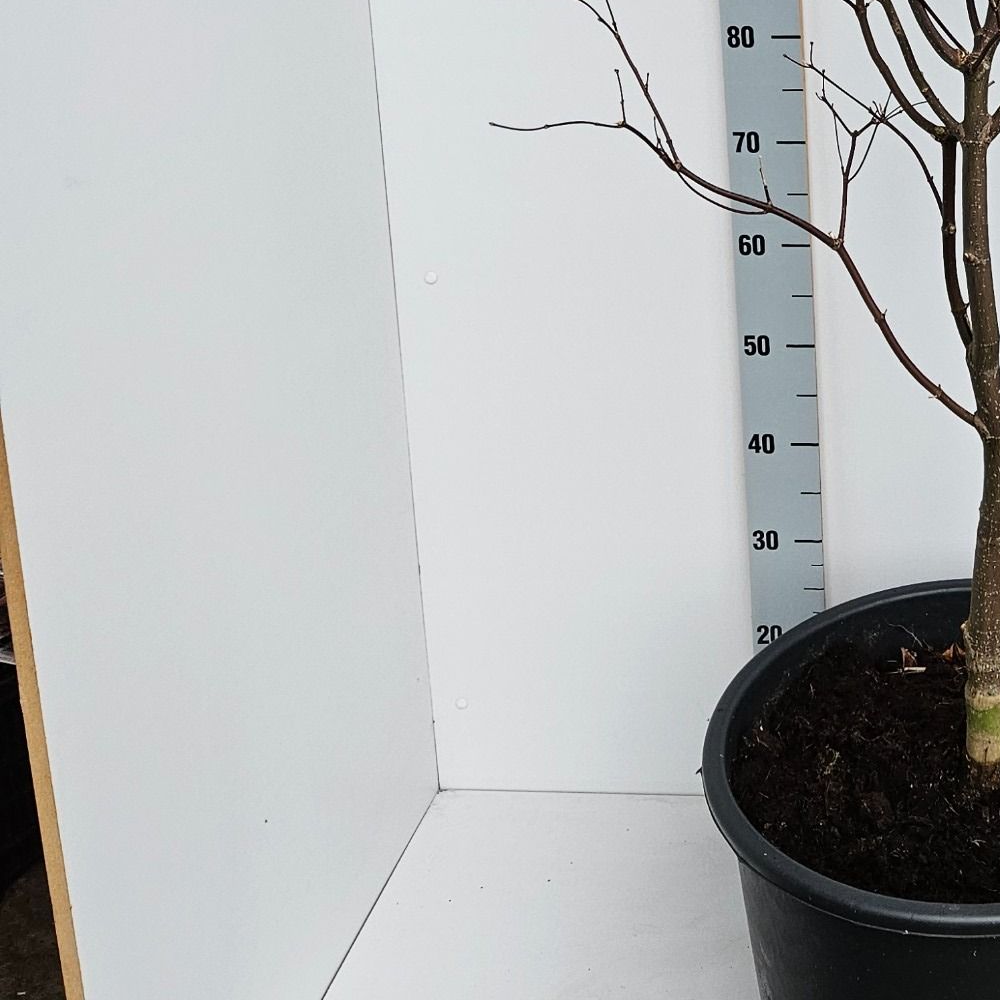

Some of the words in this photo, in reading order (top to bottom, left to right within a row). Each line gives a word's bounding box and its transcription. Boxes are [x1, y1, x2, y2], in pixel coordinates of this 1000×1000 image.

[727, 26, 754, 48] 80
[733, 132, 759, 153] 70
[739, 235, 765, 255] 60
[744, 335, 770, 356] 50
[748, 434, 775, 454] 40
[753, 530, 778, 550] 30
[757, 625, 782, 644] 20
